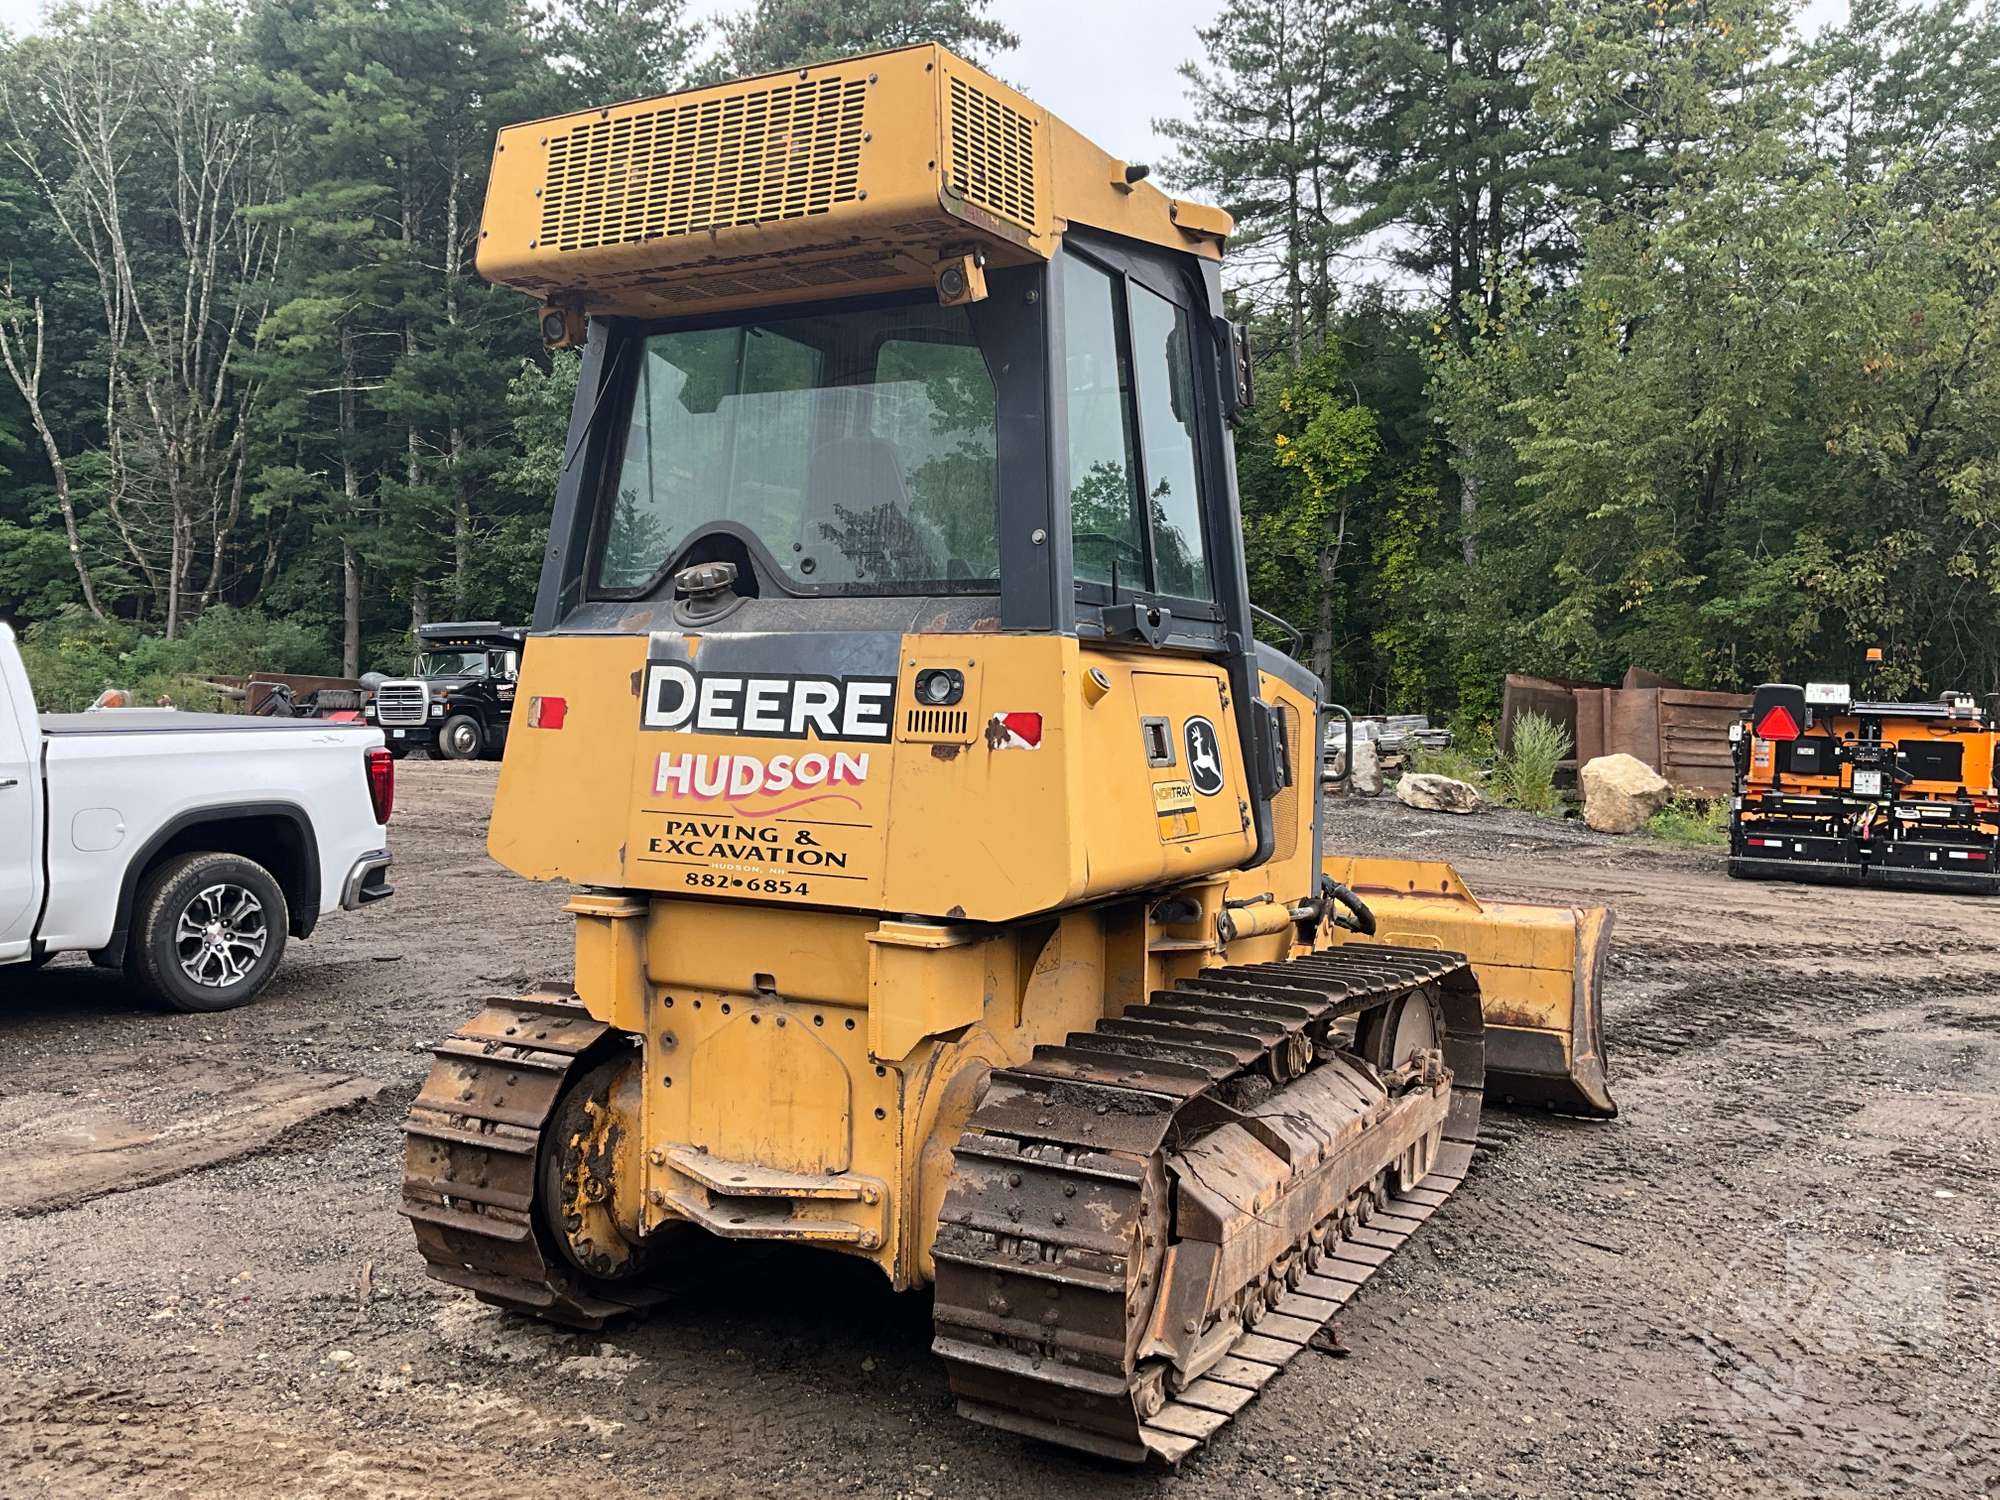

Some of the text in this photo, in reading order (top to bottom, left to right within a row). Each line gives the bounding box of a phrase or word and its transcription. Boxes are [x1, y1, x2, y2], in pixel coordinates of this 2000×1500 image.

[644, 664, 893, 738] DEERE
[653, 751, 870, 799] HUDSON
[1155, 785, 1192, 801] NORTRAX
[665, 821, 822, 847] PAVING &
[648, 838, 847, 869] EXCAVATION
[768, 867, 785, 875] NH
